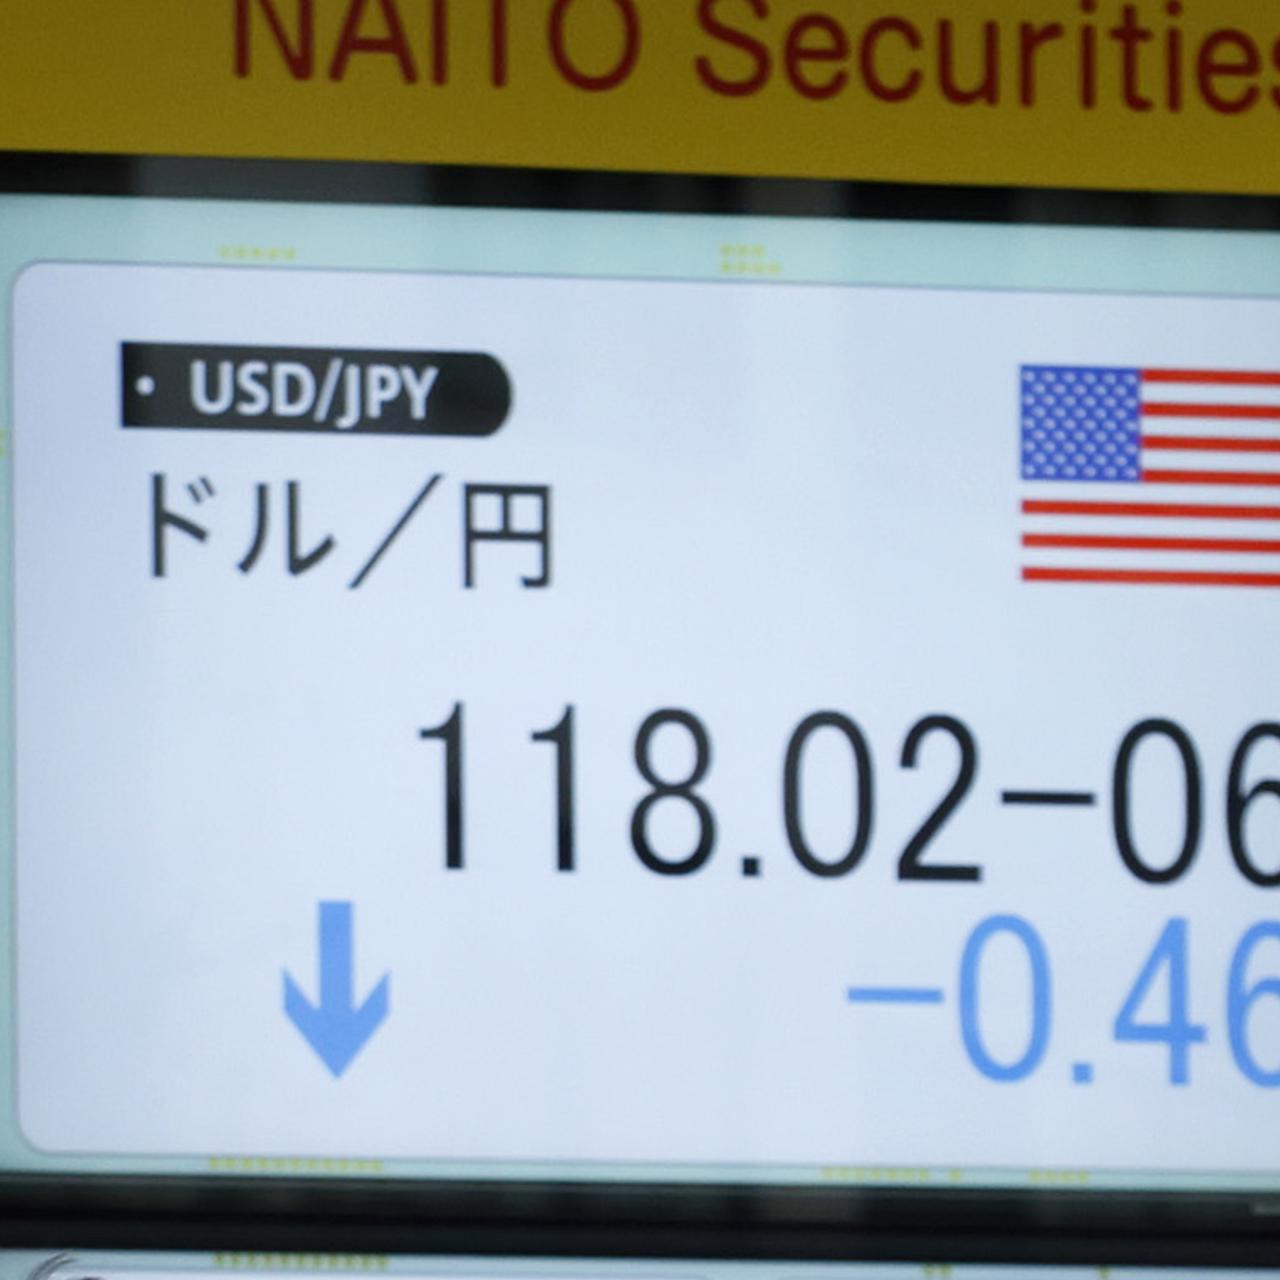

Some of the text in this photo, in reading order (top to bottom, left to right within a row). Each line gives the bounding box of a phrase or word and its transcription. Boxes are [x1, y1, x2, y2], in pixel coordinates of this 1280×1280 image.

[232, 0, 1280, 117] NAITO Securitie
[183, 357, 439, 432] USD/JPY
[151, 472, 552, 590] ドル／円
[419, 702, 1280, 890] 118.02-06
[846, 913, 1280, 1090] -0.46
